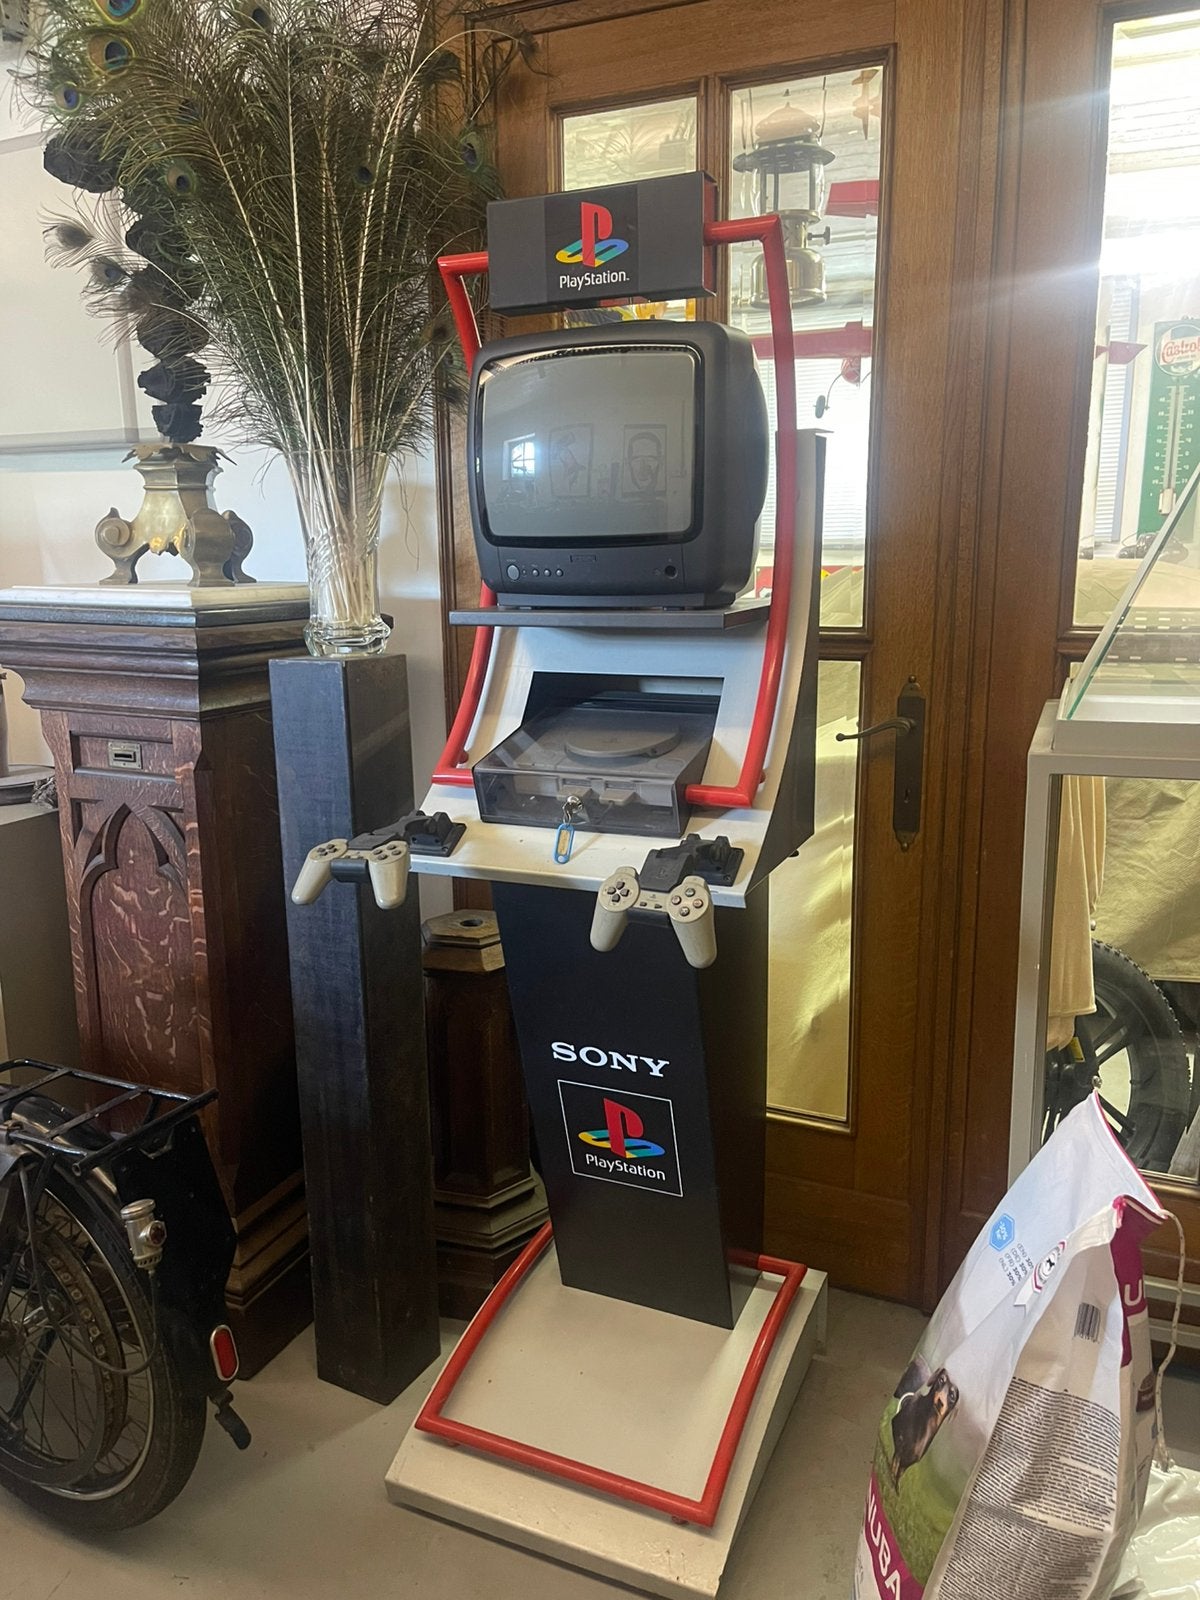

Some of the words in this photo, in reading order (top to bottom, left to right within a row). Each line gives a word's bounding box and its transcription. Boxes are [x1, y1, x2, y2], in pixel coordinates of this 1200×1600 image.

[560, 270, 627, 291] PlayStation
[551, 1041, 670, 1078] SONY
[585, 1153, 666, 1181] PlayStation
